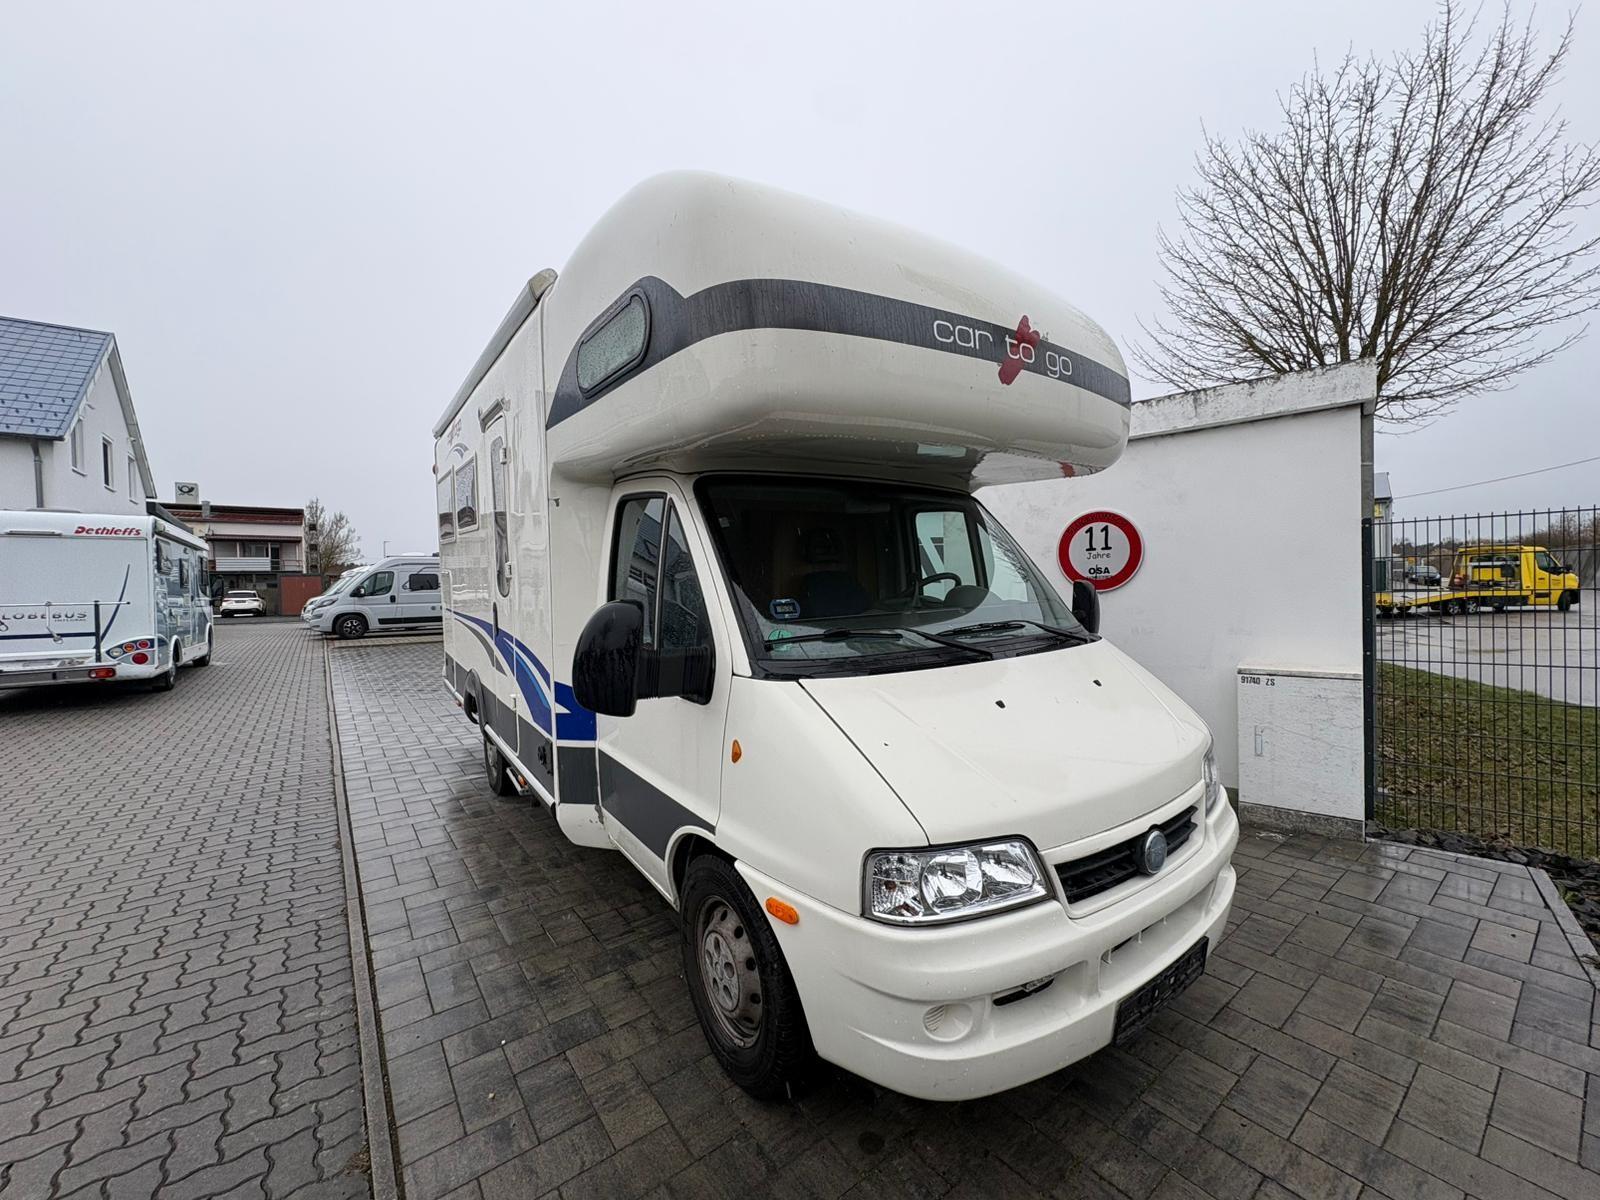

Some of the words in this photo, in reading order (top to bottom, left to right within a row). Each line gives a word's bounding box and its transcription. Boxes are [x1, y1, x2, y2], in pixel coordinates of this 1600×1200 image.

[933, 320, 993, 350] car
[1004, 334, 1036, 363] to
[1046, 351, 1073, 378] go
[74, 525, 143, 536] Dethleffs
[1085, 525, 1112, 551] 11
[1086, 552, 1111, 560] Jahre
[1241, 676, 1260, 685] 91740
[1266, 678, 1275, 686] ZS
